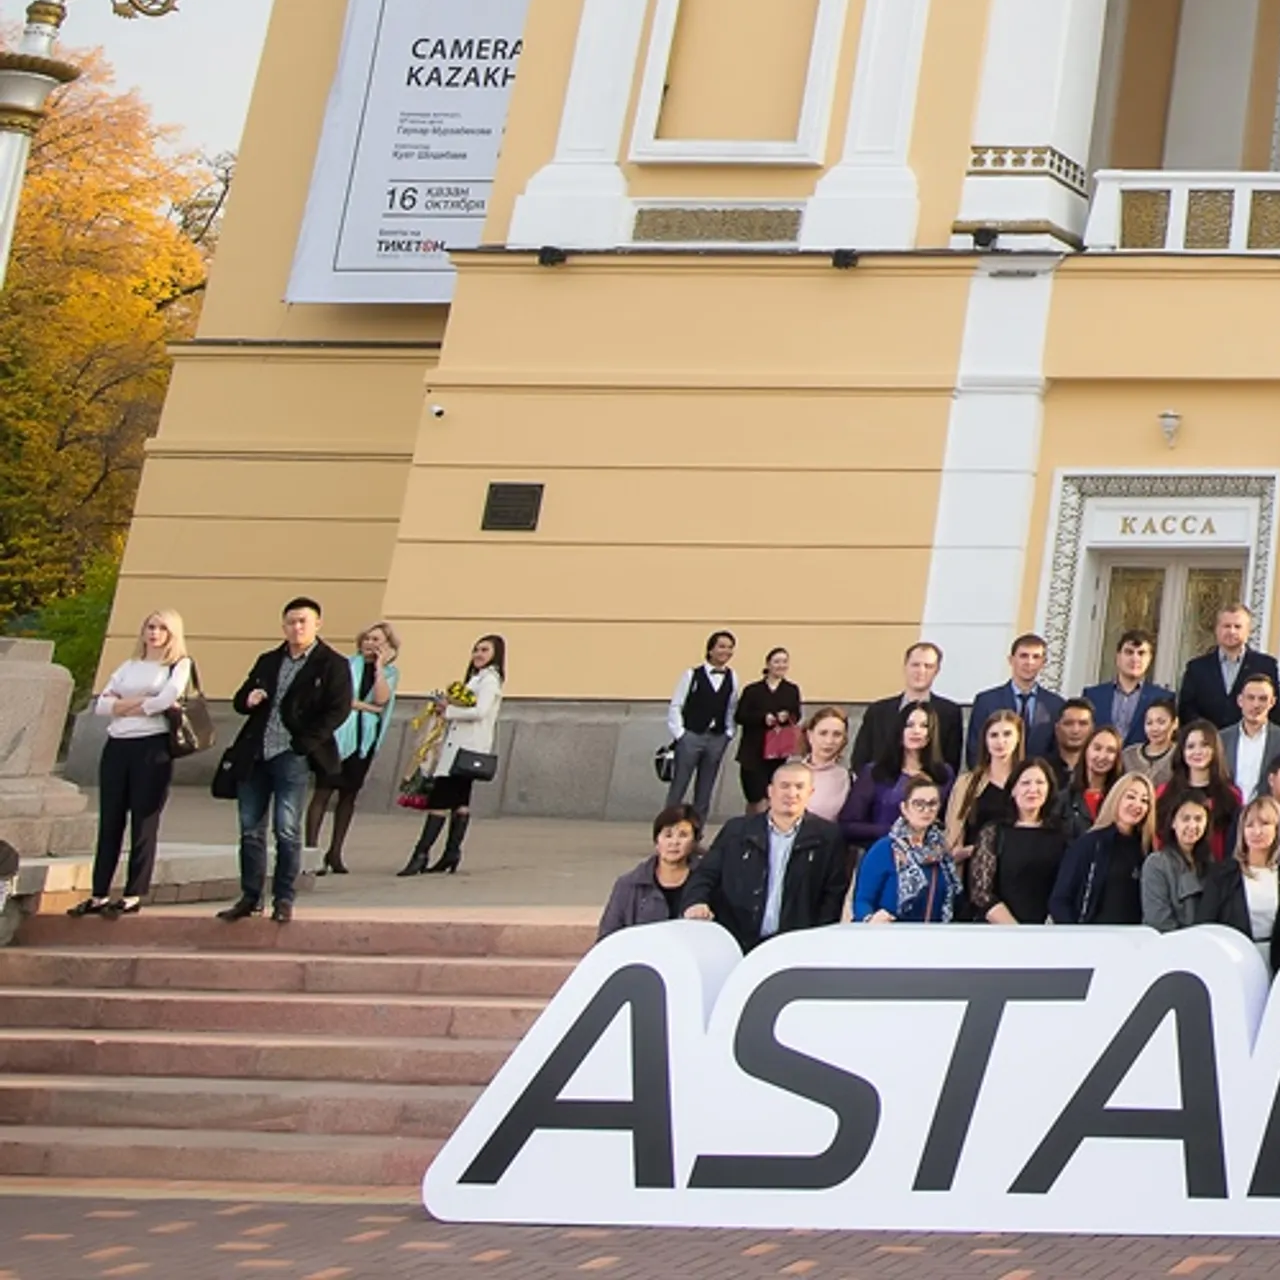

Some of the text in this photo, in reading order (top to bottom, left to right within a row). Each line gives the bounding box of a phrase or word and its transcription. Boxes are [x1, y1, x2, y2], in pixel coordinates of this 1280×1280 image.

[411, 38, 524, 60] CAMERA
[387, 186, 419, 211] 16
[424, 198, 485, 213] октября
[1119, 515, 1217, 536] КАССА
